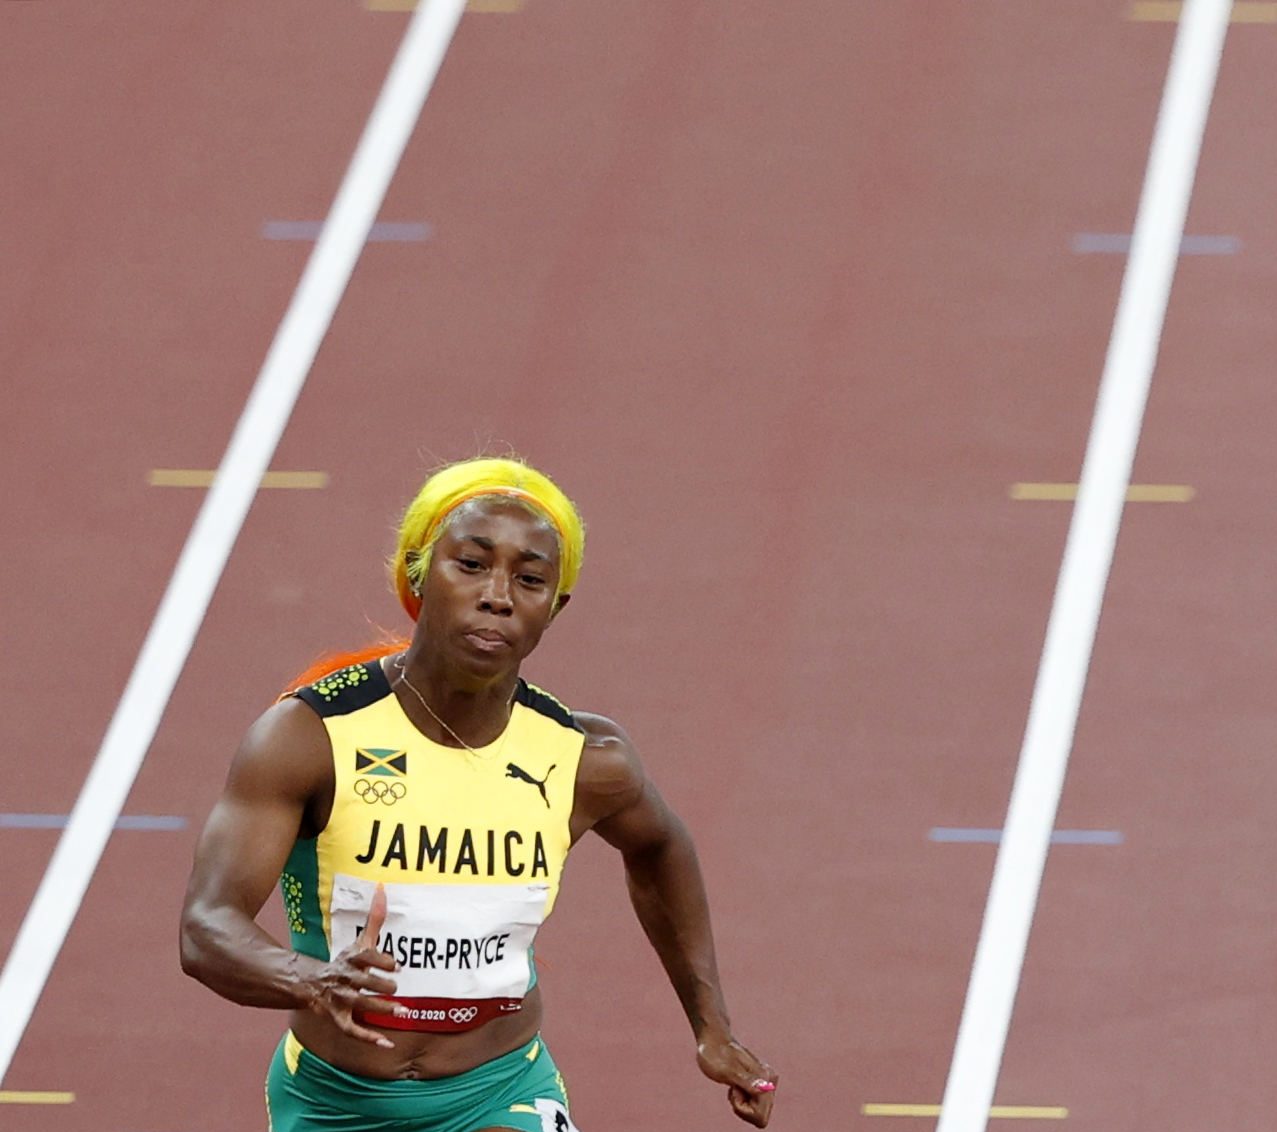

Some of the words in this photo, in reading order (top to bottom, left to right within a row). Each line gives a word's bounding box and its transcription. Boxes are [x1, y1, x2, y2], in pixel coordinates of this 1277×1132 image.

[355, 819, 549, 878] JAMAICA
[355, 925, 511, 970] ASER-PRYCE
[420, 1009, 446, 1021] 2020
